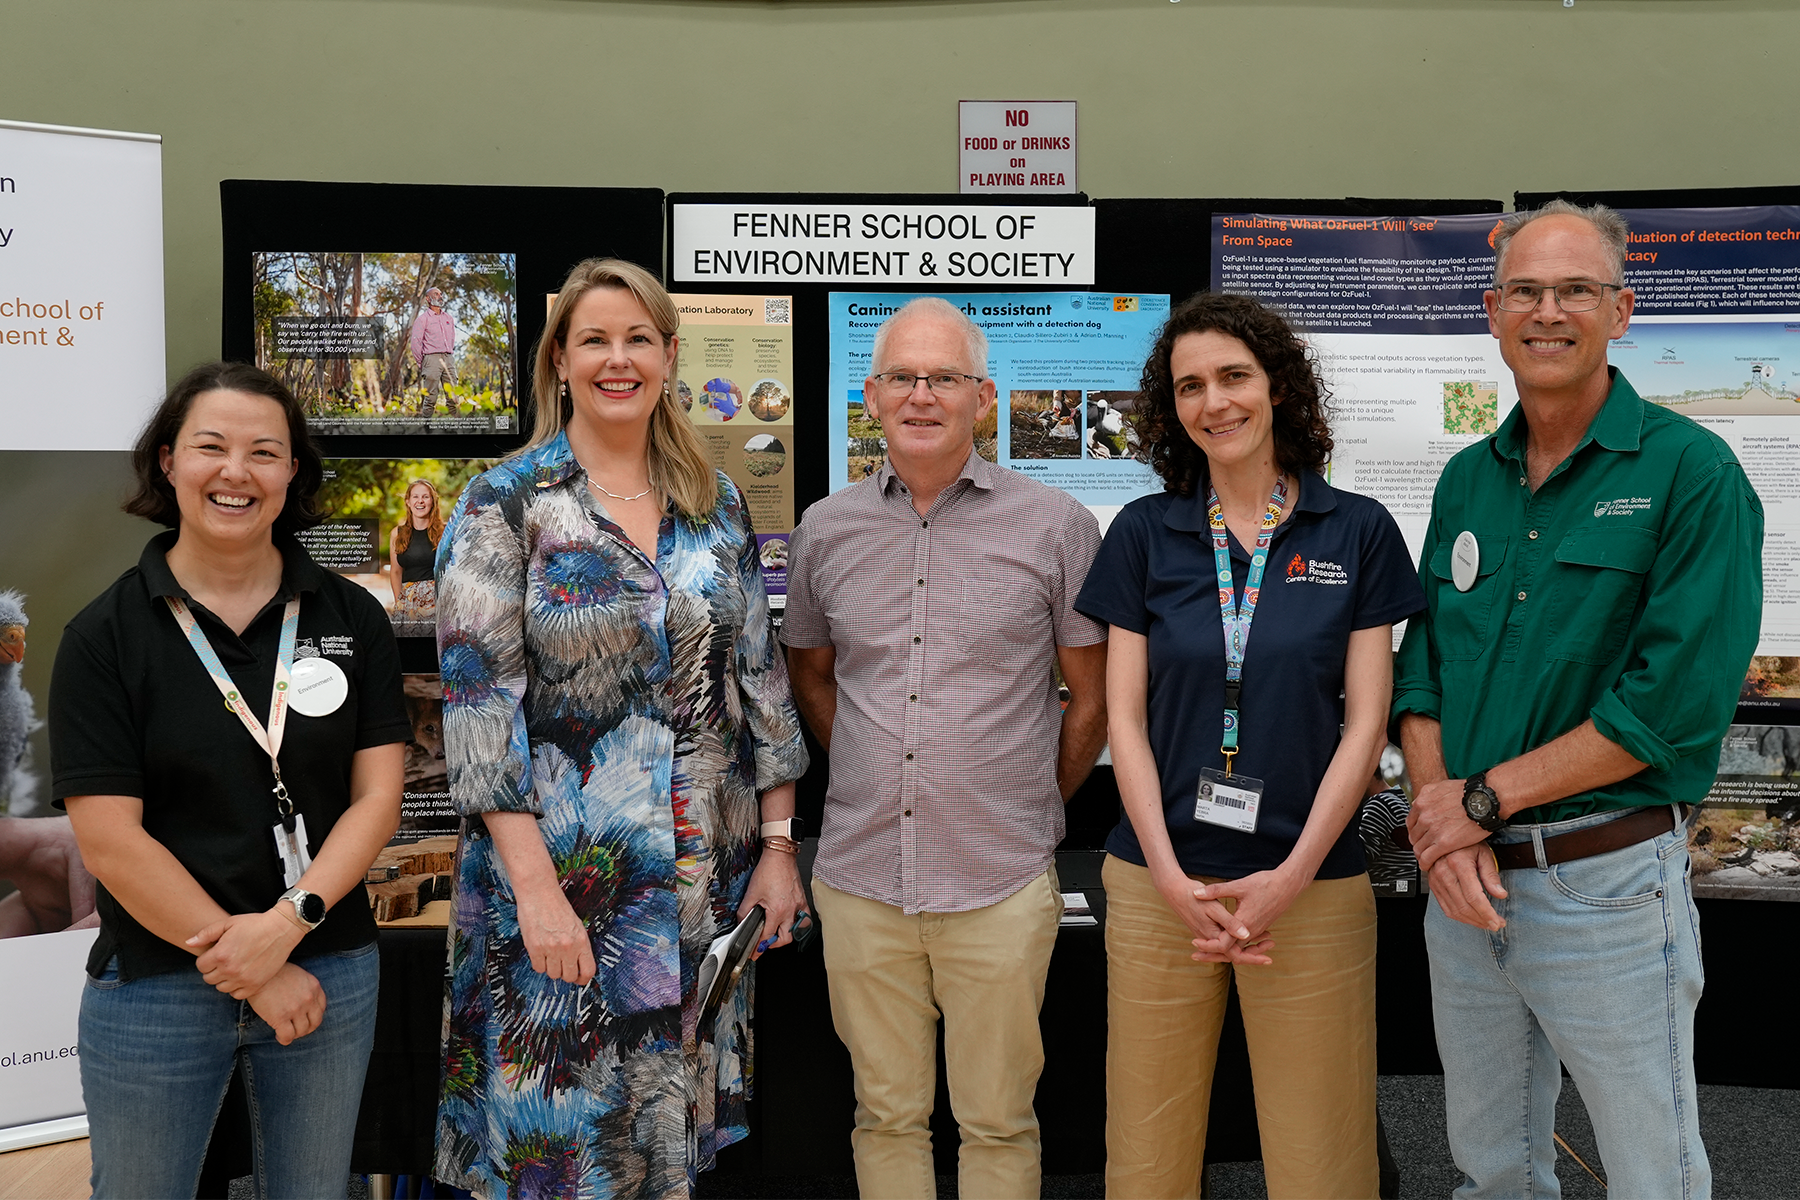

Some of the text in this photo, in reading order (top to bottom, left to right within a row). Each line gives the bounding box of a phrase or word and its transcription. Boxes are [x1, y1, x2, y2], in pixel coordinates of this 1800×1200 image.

[1005, 110, 1029, 126] NO
[965, 137, 1070, 150] FOOD or DRINKS
[1010, 158, 1025, 168] on
[970, 173, 1065, 186] PLAYING AREA
[733, 213, 1036, 240] FENNER SCHOOL OF
[1223, 218, 1287, 231] Simulating
[1290, 219, 1323, 229] What
[1326, 220, 1378, 230] OzFuel-1
[1382, 221, 1405, 231] Will
[1223, 235, 1292, 248] From Space
[1681, 231, 1695, 242] of
[1698, 230, 1762, 242] detection
[694, 250, 1075, 277] ENVIRONMENT & SOCIETY
[79, 301, 104, 320] of
[705, 306, 753, 316] Laboratory
[982, 304, 1051, 316] assistant
[1086, 320, 1101, 329] dog
[56, 326, 74, 347] &
[1309, 560, 1342, 571] Bushfire
[1309, 568, 1347, 578] Research
[298, 676, 333, 694] Environment
